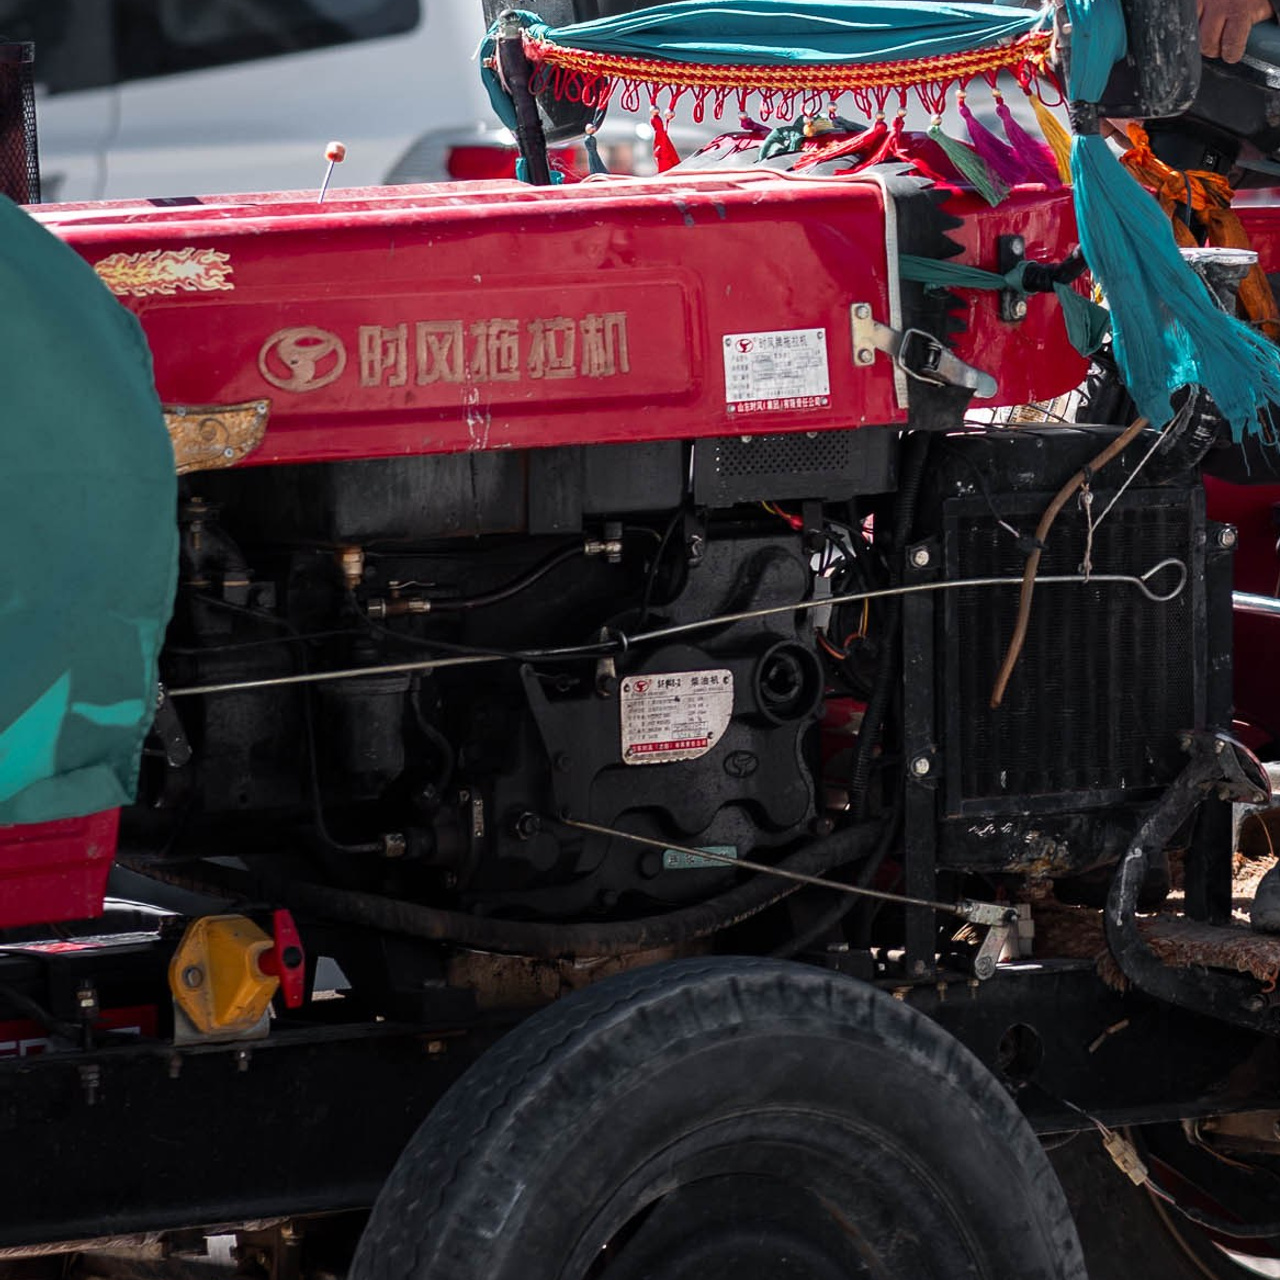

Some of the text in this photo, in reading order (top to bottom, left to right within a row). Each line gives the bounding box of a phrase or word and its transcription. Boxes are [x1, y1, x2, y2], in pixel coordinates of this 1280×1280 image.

[359, 311, 630, 388] 时风拖拉机
[691, 675, 719, 686] 柴油机
